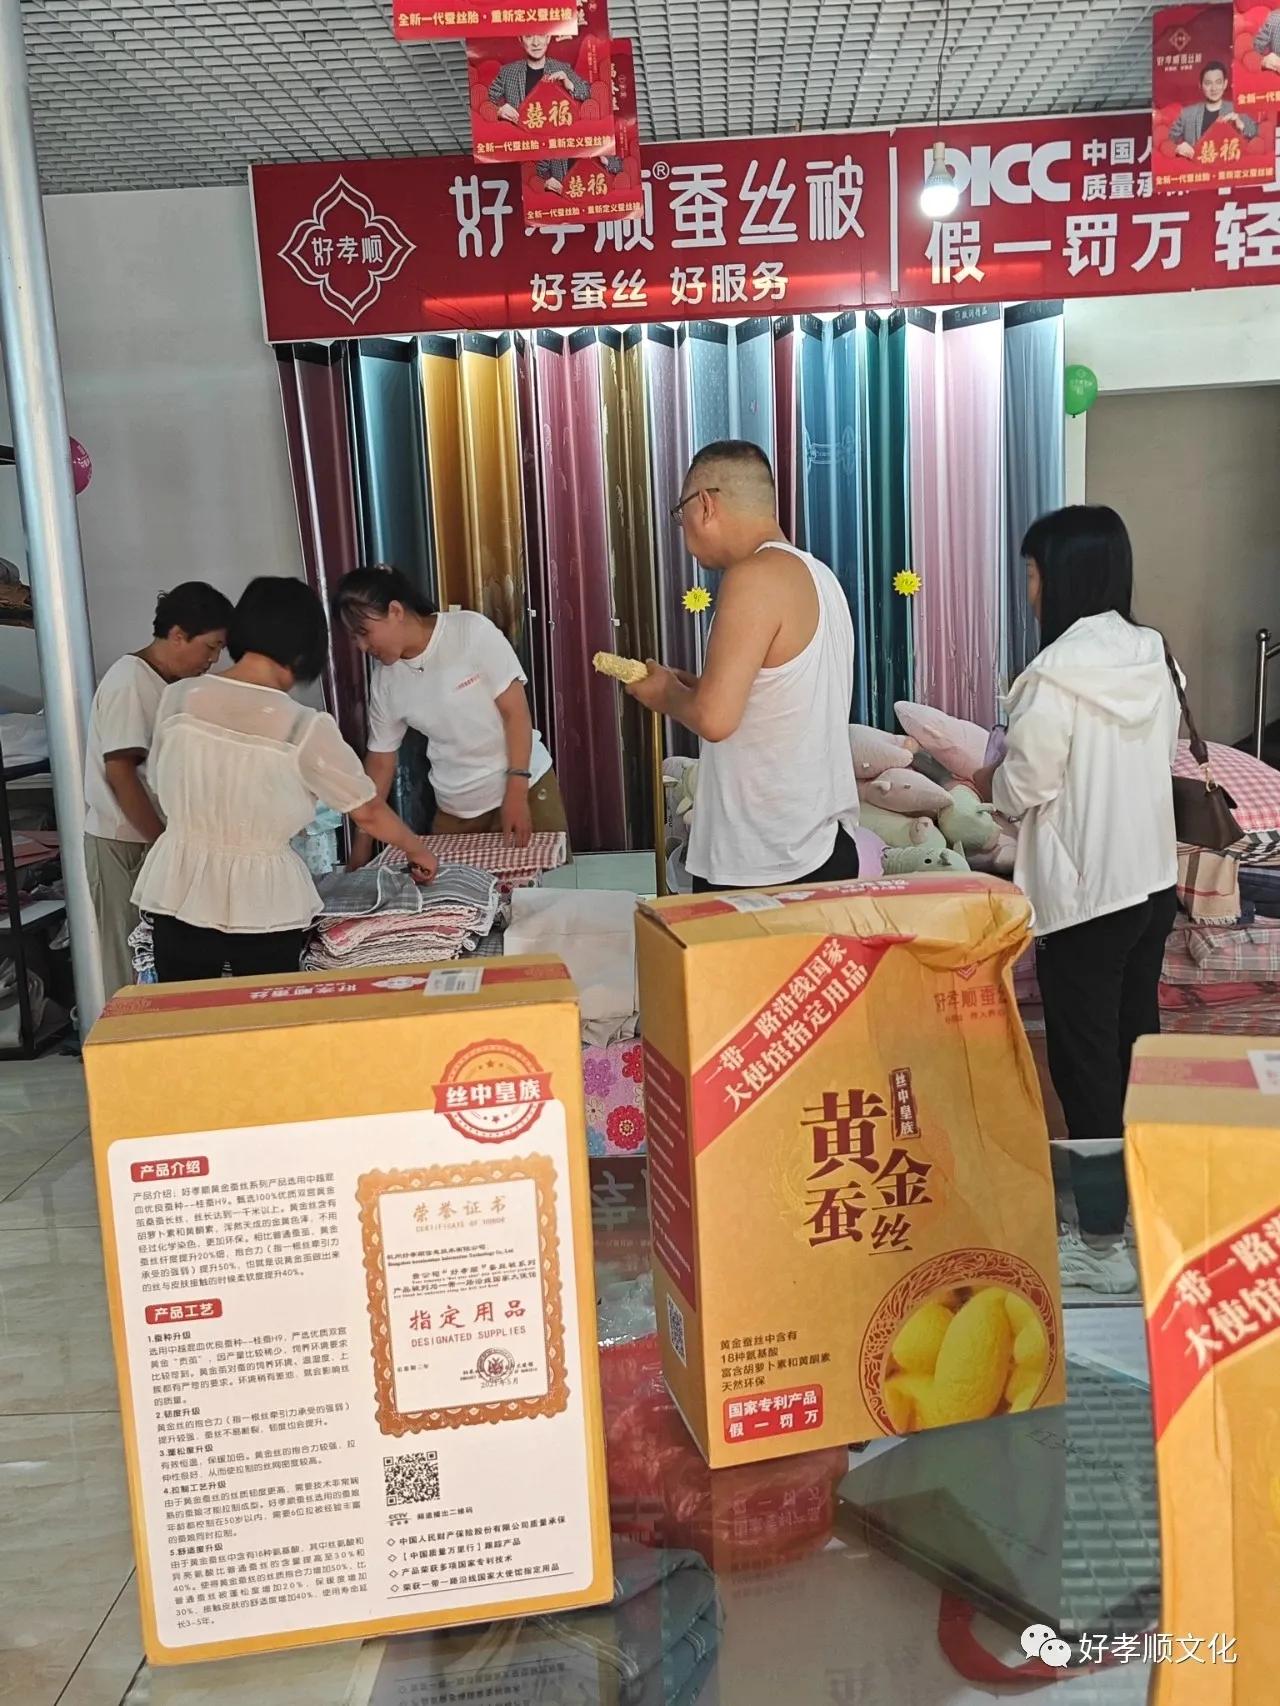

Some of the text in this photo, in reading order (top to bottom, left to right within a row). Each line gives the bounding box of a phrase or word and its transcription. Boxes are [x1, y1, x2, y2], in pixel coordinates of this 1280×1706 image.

[311, 235, 383, 266] 好孝顺
[924, 211, 1190, 284] 假一罚万
[530, 262, 788, 312] 好蚕丝 好服务
[705, 938, 848, 1084] 一带一路沿线国家
[723, 959, 868, 1113] 大使馆指定用品
[446, 1078, 541, 1108] 丝中皇族
[140, 1159, 201, 1179] 产品介绍
[800, 1089, 933, 1257] 黄金蚕丝
[154, 1303, 214, 1321] 产品工艺
[409, 1299, 526, 1331] 指定用品
[411, 1326, 526, 1347] DESIGNATED SUPPLIES
[720, 1330, 798, 1350] 黄金蚕丝中含有
[721, 1347, 779, 1364] 18种氨基酸
[721, 1352, 831, 1378] 富含胡萝卜素和黄酮素
[722, 1376, 765, 1392] 天然环保
[728, 1391, 817, 1418] 国家专利产品
[729, 1409, 819, 1438] 假一罚万
